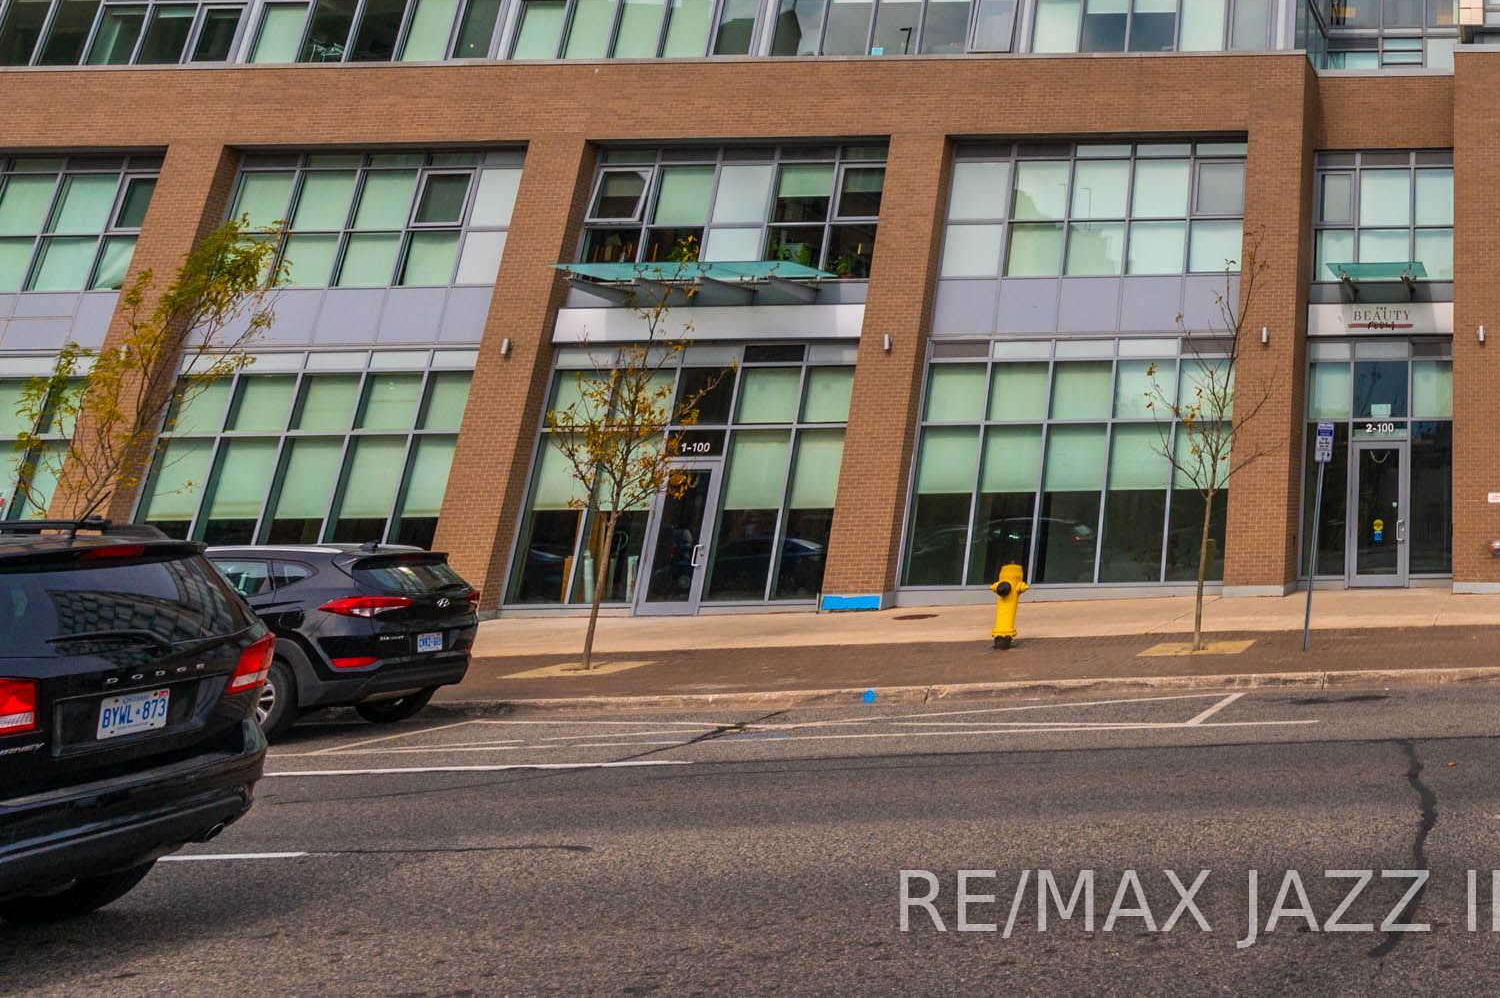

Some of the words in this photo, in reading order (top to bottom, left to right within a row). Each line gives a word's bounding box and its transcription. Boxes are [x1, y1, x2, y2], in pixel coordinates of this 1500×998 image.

[1354, 310, 1409, 321] BEAUTY
[1365, 423, 1394, 433] 2-100
[680, 442, 711, 453] 1-100
[106, 662, 206, 685] DODGE
